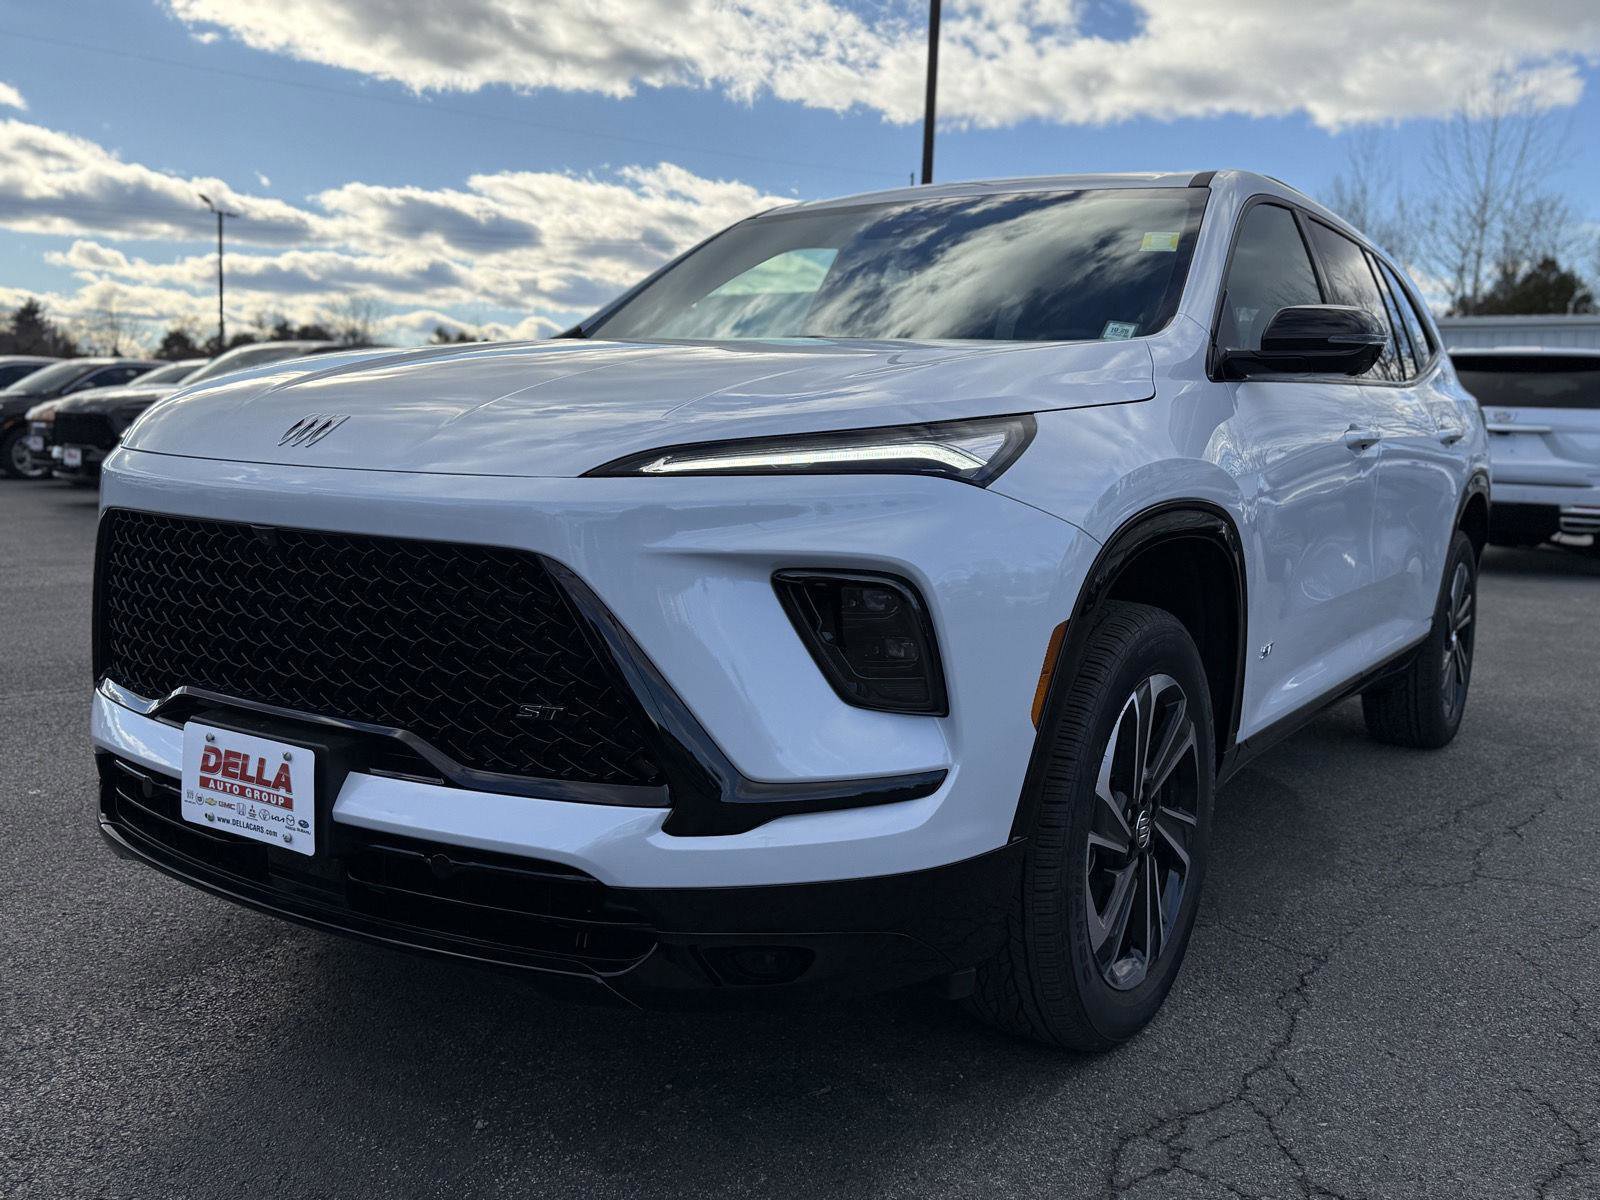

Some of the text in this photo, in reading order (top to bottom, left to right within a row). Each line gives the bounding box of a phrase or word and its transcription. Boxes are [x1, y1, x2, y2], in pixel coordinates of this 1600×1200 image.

[515, 704, 566, 721] ST
[200, 745, 293, 795] DELLA
[208, 779, 285, 806] AUTO GROUP
[218, 801, 236, 811] GMC
[217, 816, 278, 837] www.DELLACARS.com
